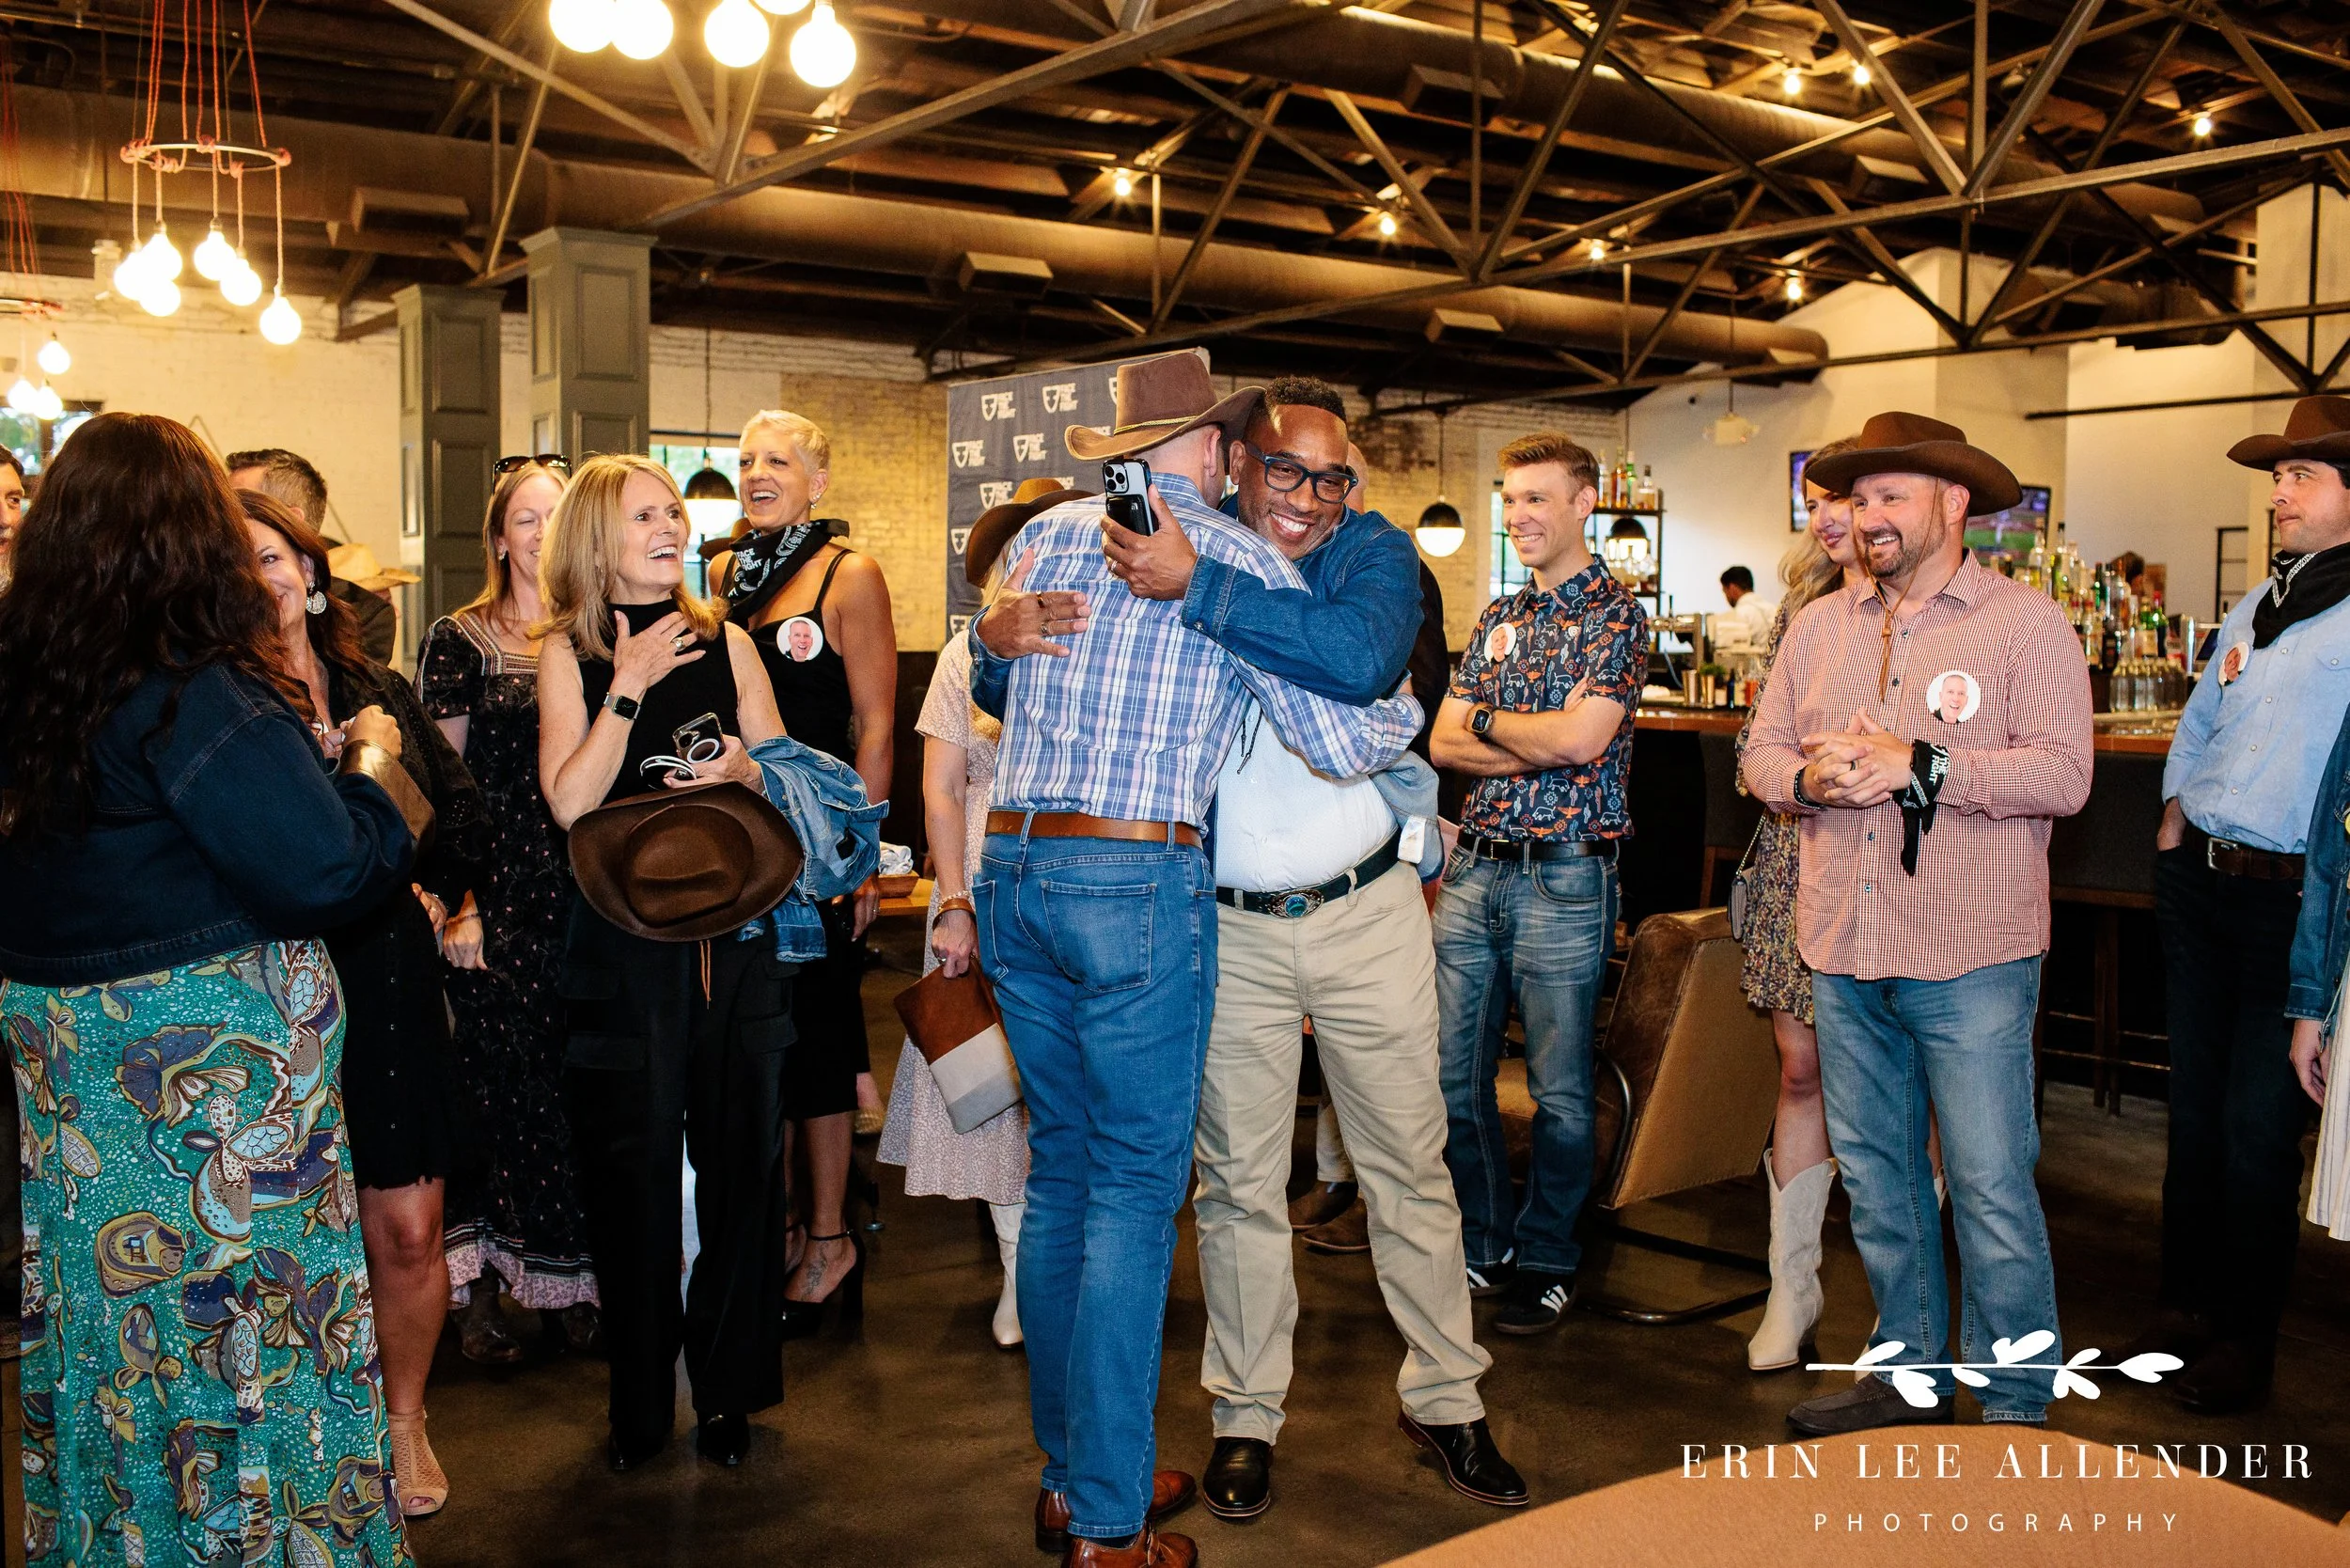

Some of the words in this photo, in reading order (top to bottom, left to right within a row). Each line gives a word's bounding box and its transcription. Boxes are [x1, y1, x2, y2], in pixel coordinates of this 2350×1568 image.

[736, 548, 755, 558] FACE
[1929, 755, 1940, 784] FIGHT
[1938, 757, 1949, 776] THE
